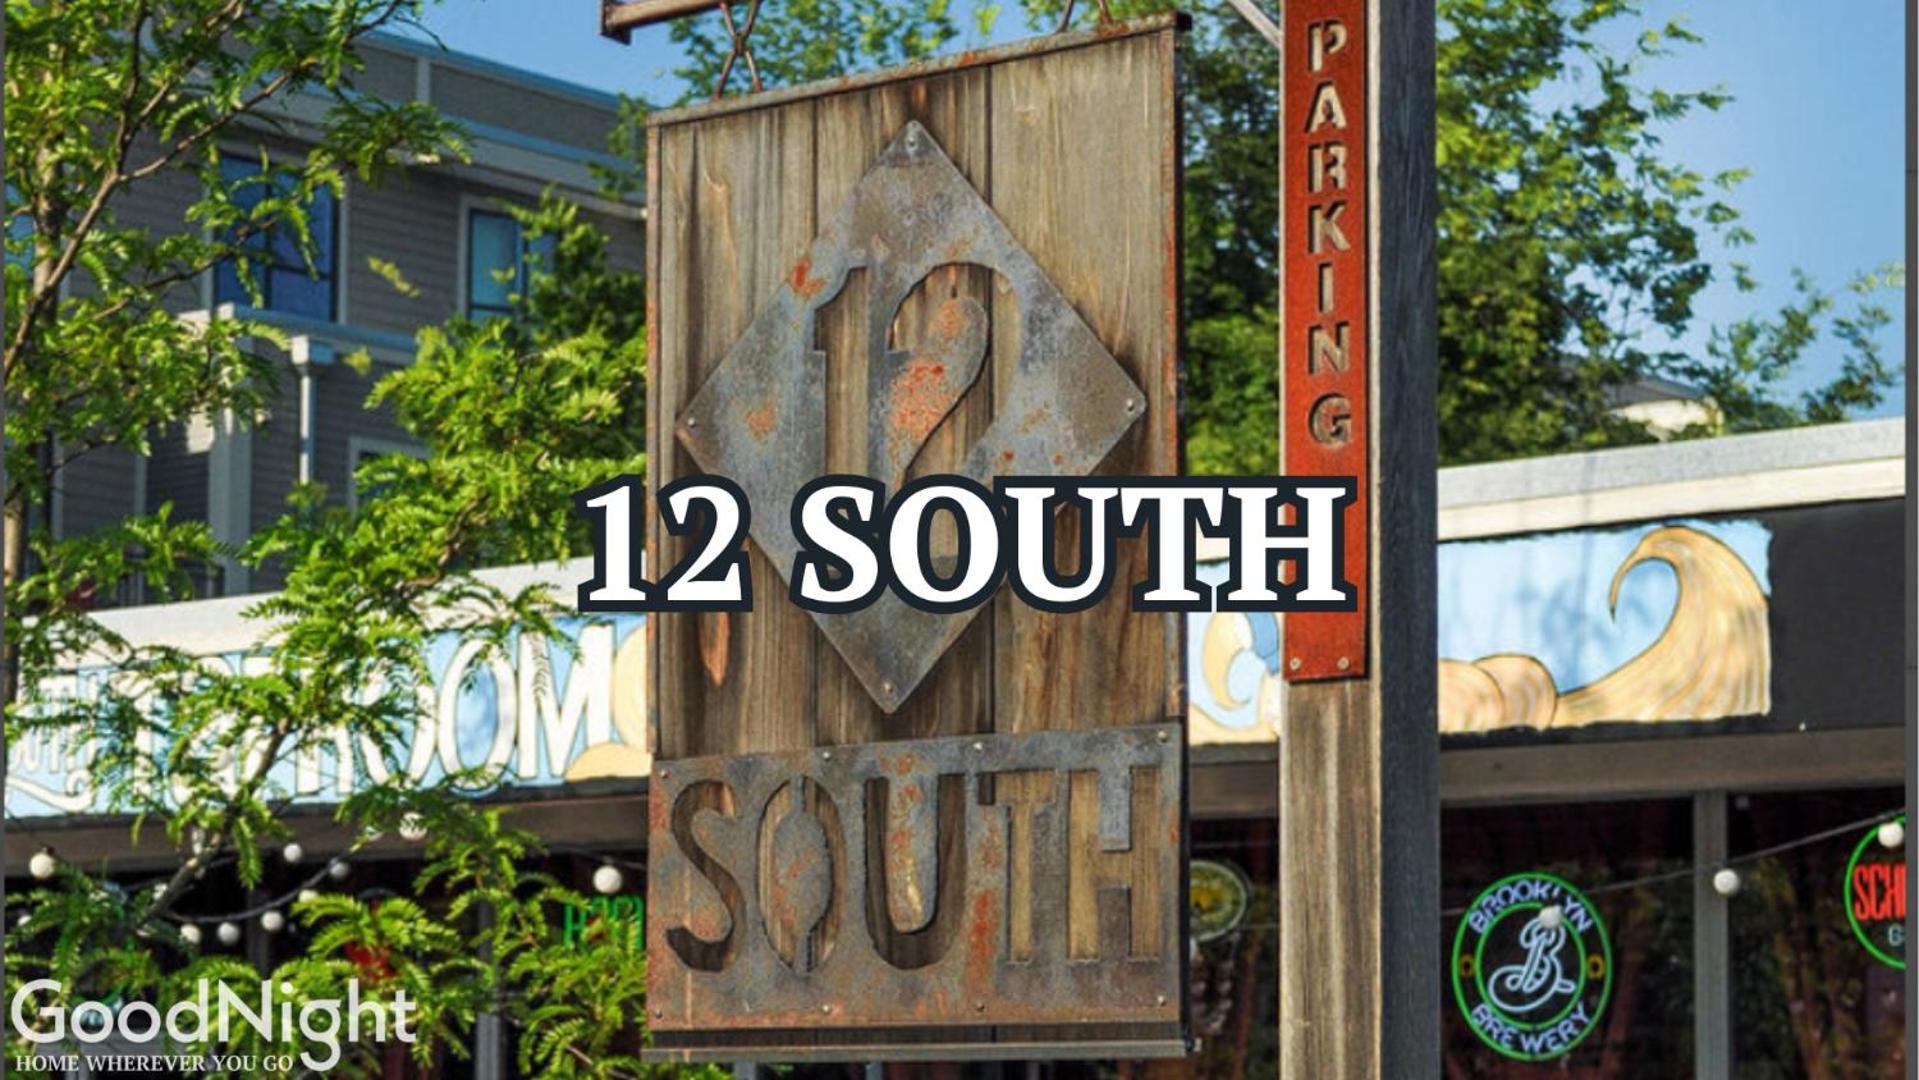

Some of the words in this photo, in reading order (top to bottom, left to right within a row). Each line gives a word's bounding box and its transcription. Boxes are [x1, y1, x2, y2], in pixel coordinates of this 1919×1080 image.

[1304, 20, 1353, 448] PARKING
[812, 260, 1023, 500] 12
[665, 764, 1162, 972] SOUTH
[1471, 1001, 1591, 1052] BREWERY
